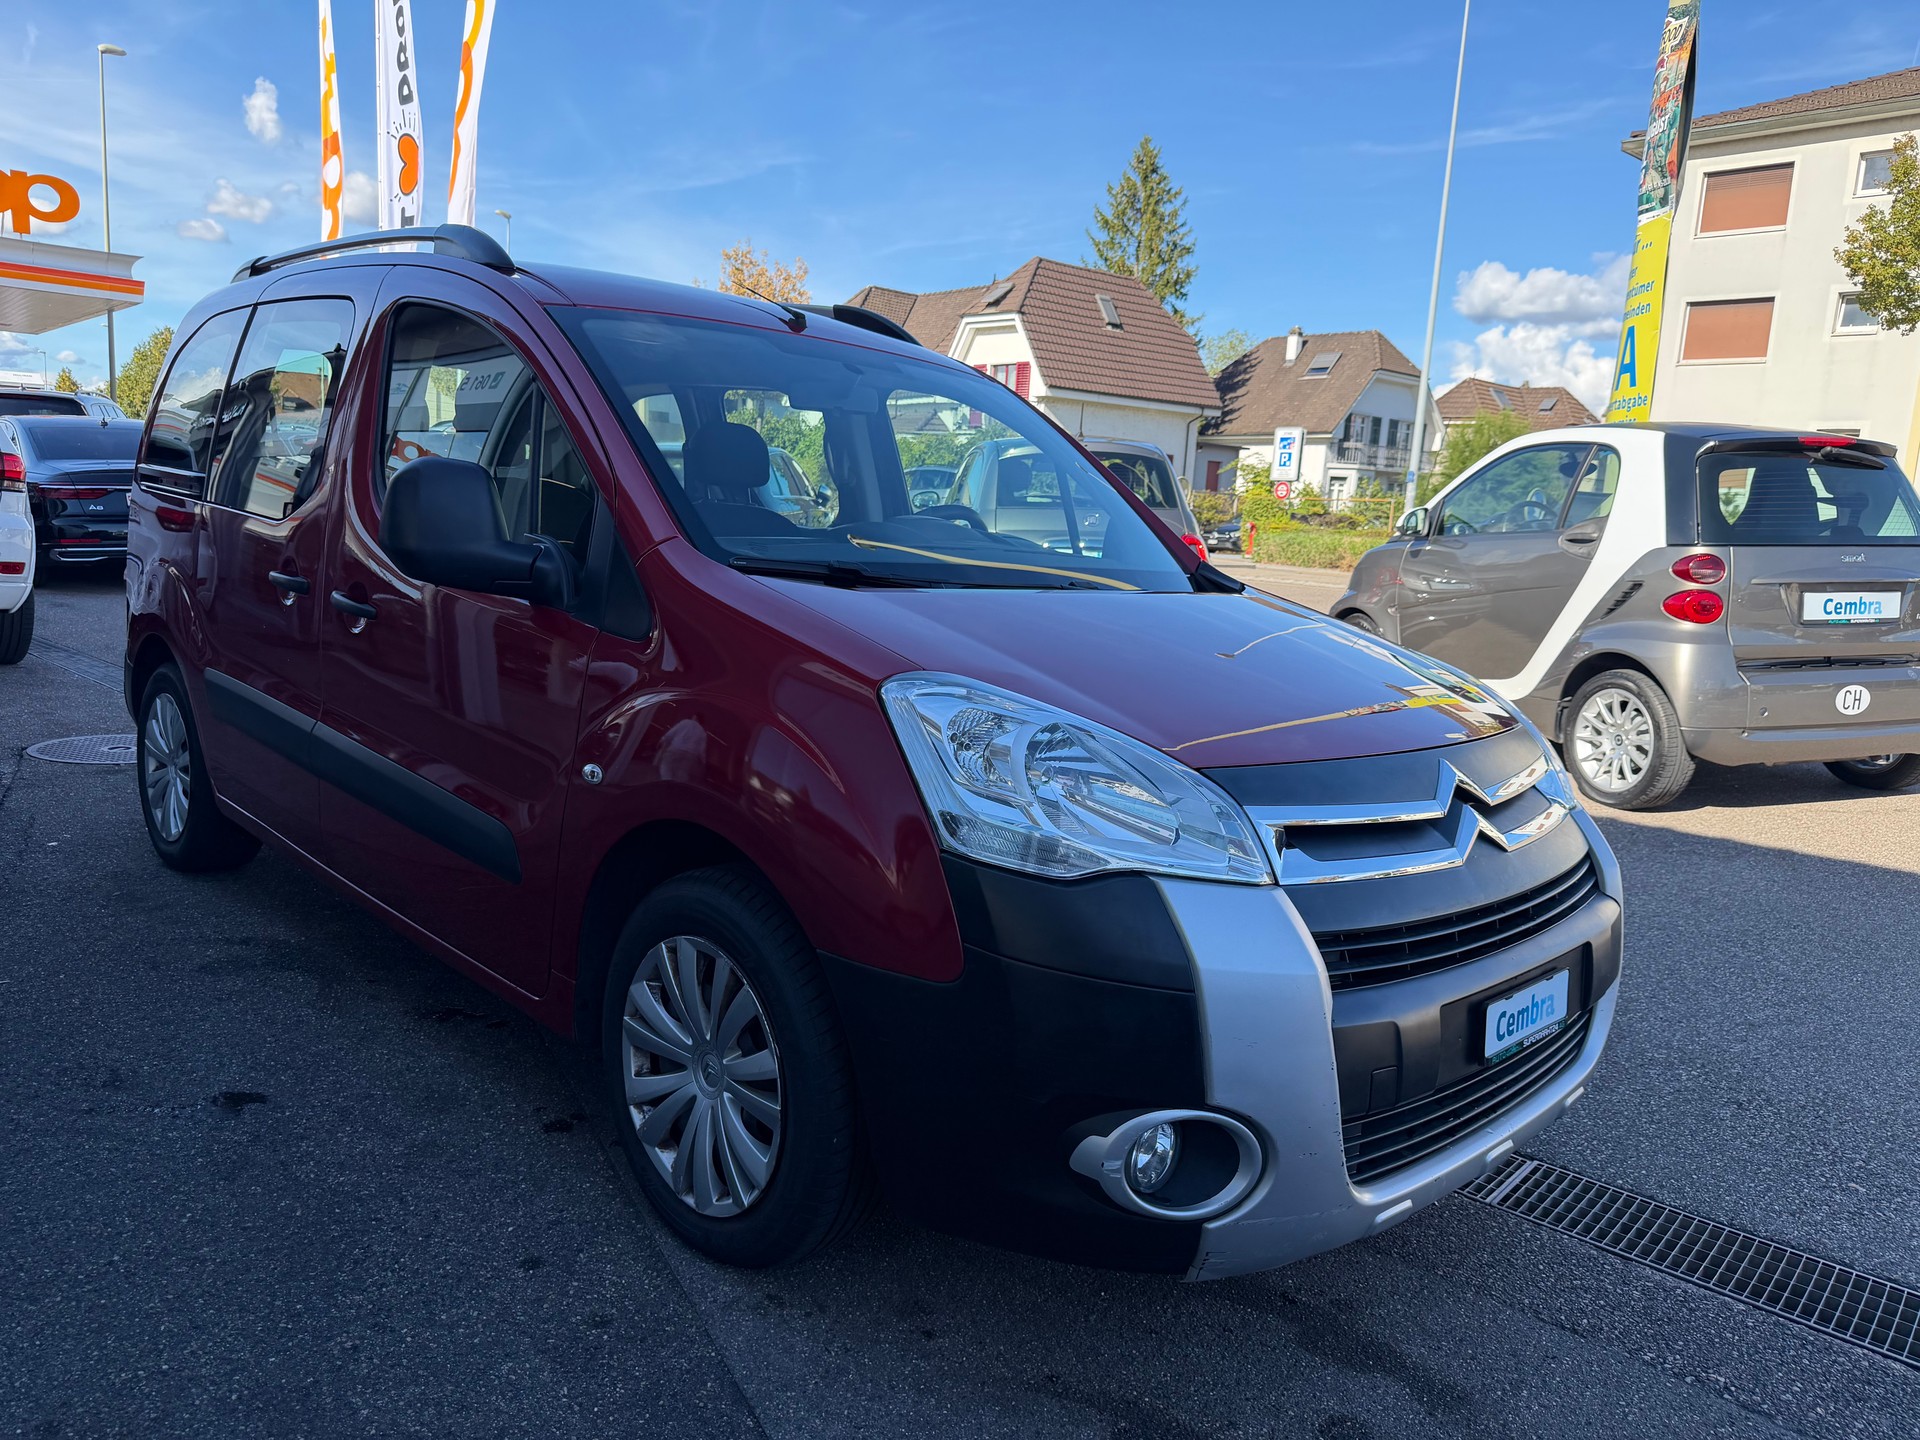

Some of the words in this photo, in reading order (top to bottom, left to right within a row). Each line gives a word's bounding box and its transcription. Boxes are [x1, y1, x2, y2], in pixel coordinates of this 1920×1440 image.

[392, 0, 414, 106] DRO
[0, 169, 80, 235] p
[1823, 596, 1882, 616] Cembra
[1842, 689, 1862, 710] CH
[1496, 993, 1555, 1042] Cembra
